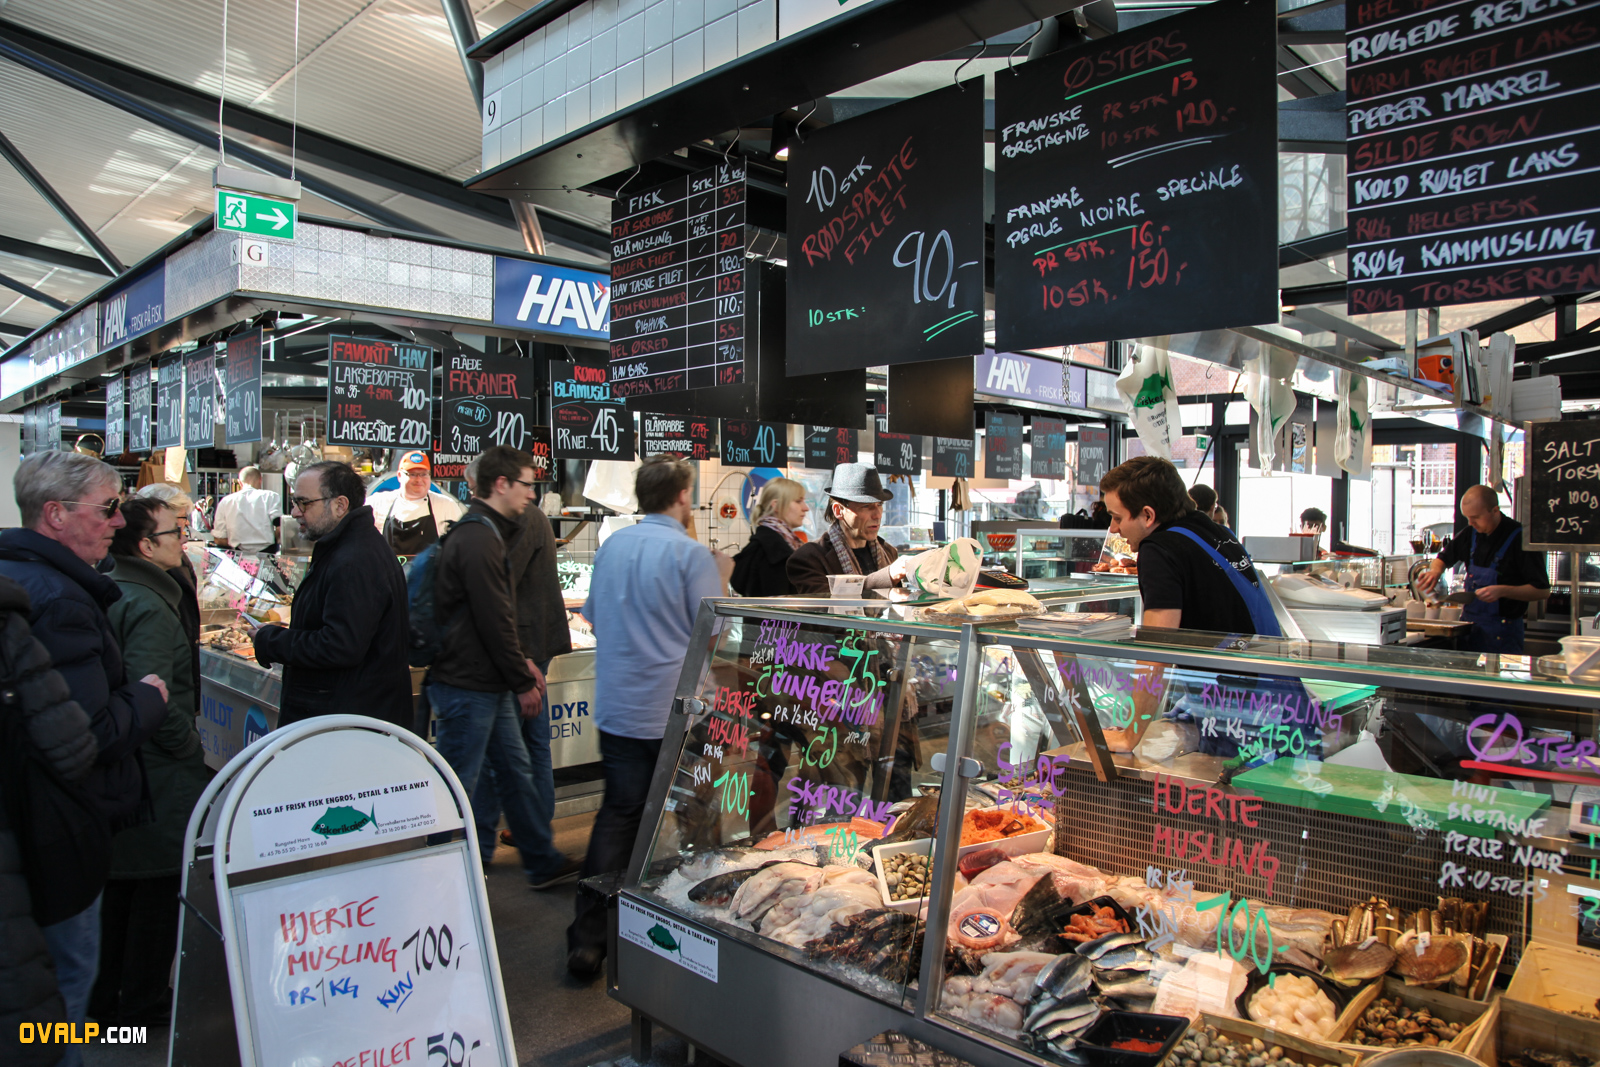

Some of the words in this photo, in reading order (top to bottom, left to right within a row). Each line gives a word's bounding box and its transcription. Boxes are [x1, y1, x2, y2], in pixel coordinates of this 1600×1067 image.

[1347, 15, 1460, 63] RØGEDE
[1063, 30, 1188, 96] ØSTERS
[1351, 68, 1410, 95] VARM
[1514, 21, 1598, 58] LAKS
[487, 99, 496, 127] 9
[1101, 103, 1124, 123] PR
[1130, 93, 1168, 114] STK
[1349, 96, 1432, 134] PEBER
[1441, 69, 1561, 112] MAKREL
[1002, 105, 1083, 142] FRANSKE
[1100, 130, 1118, 150] 10
[1123, 123, 1160, 144] STK
[1002, 123, 1091, 158] BRETAGNE
[1354, 131, 1440, 171] SILDE
[1450, 109, 1543, 151] ROGN
[806, 165, 837, 212] 10
[840, 156, 872, 195] STK
[1354, 174, 1409, 204] KOLD
[1420, 161, 1495, 194] RØGET
[1507, 143, 1580, 179] LAKS
[629, 189, 665, 214] FISK
[692, 178, 714, 193] STK
[801, 136, 918, 268] RØDSPÆTTE
[1006, 186, 1085, 224] FRANSKE
[632, 208, 675, 233] SKRUBBE
[844, 184, 908, 265] FILET
[1407, 195, 1539, 233] HELLEFISK
[1006, 217, 1063, 249] PERLE
[247, 244, 264, 262] G
[612, 257, 647, 280] KULLER
[648, 251, 676, 269] FILET
[719, 233, 737, 250] 70
[1033, 251, 1060, 278] PR
[1352, 248, 1405, 279] RØG
[1421, 220, 1596, 268] KAMMUSLING
[612, 281, 629, 299] HAV
[630, 276, 655, 295] TASKE
[658, 269, 684, 288] FILET
[892, 229, 979, 309] 90,-
[516, 275, 610, 331] HAV
[1042, 283, 1064, 311] 10
[103, 294, 128, 346] HAV
[131, 314, 144, 333] FRISK
[151, 304, 163, 324] FISK
[635, 315, 668, 334] PIGHVAR
[809, 308, 824, 328] 10
[399, 347, 427, 368] HAV
[610, 341, 629, 358] HEL
[631, 337, 669, 357] ØRRED
[335, 366, 415, 388] LAKSEBØFFER
[449, 370, 519, 399] FASANER
[612, 364, 628, 380] HAV
[628, 362, 649, 378] BARS
[654, 374, 682, 391] FILET
[986, 356, 1031, 394] HAV
[1039, 385, 1057, 400] FRISK
[335, 385, 345, 395] STK
[365, 385, 375, 399] 4
[376, 389, 393, 401] STK
[345, 404, 366, 419] HEL
[645, 416, 685, 432] BLÅKRABBE
[451, 425, 461, 453] 3
[463, 434, 480, 453] STK
[557, 428, 571, 450] PR
[644, 440, 692, 451] TASKEKRABBE
[727, 440, 734, 462] 3
[1543, 439, 1600, 463] SALT
[1556, 516, 1589, 535] 25,-
[772, 671, 840, 710] VINGE
[1044, 684, 1054, 703] 10
[1058, 660, 1164, 703] KAMMUSLING
[202, 694, 233, 730] VILDT
[551, 701, 589, 720] DYR
[713, 686, 758, 719] HJERTE
[774, 705, 788, 721] PR
[803, 711, 819, 731] KG
[1200, 682, 1343, 744] KNIVMUSLING
[708, 717, 749, 759] MUSLING
[1201, 717, 1218, 738] PR
[704, 743, 713, 756] PR
[713, 745, 723, 764] KG
[1238, 737, 1264, 761] KUN
[694, 763, 711, 786] KUN
[997, 742, 1071, 797] SILDE
[253, 807, 272, 817] SALG
[274, 805, 284, 813] AF
[285, 801, 307, 812] FRISK
[308, 798, 324, 808] FISK
[325, 793, 356, 805] ENGROS,
[358, 788, 382, 799] DETAIL
[390, 784, 408, 793] TAKE
[409, 780, 430, 790] AWAY
[787, 777, 897, 837] SKÆRISING
[996, 789, 1055, 819] FILET
[1153, 771, 1264, 828] HJERTE
[1451, 780, 1498, 805] MINI
[314, 817, 368, 835] Fiskerikajen
[788, 806, 823, 825] FILET
[1446, 802, 1548, 838] BRETAGNE
[274, 838, 295, 848] Rungsted
[295, 837, 311, 845] Havn
[1445, 829, 1503, 859] PERLE
[1150, 822, 1280, 897] MUSLING
[1146, 865, 1163, 889] PR
[1167, 868, 1194, 899] KG
[280, 896, 379, 946] HJERTE
[620, 900, 630, 908] SALG
[635, 906, 646, 916] FRISK
[673, 923, 686, 934] DETAIL
[691, 931, 702, 941] TAKE
[703, 936, 716, 946] AWAY
[1135, 905, 1178, 938] KUN
[287, 936, 397, 976] MUSLING
[289, 987, 317, 1006] PR
[330, 977, 359, 999] KG
[377, 970, 414, 1009] KUN
